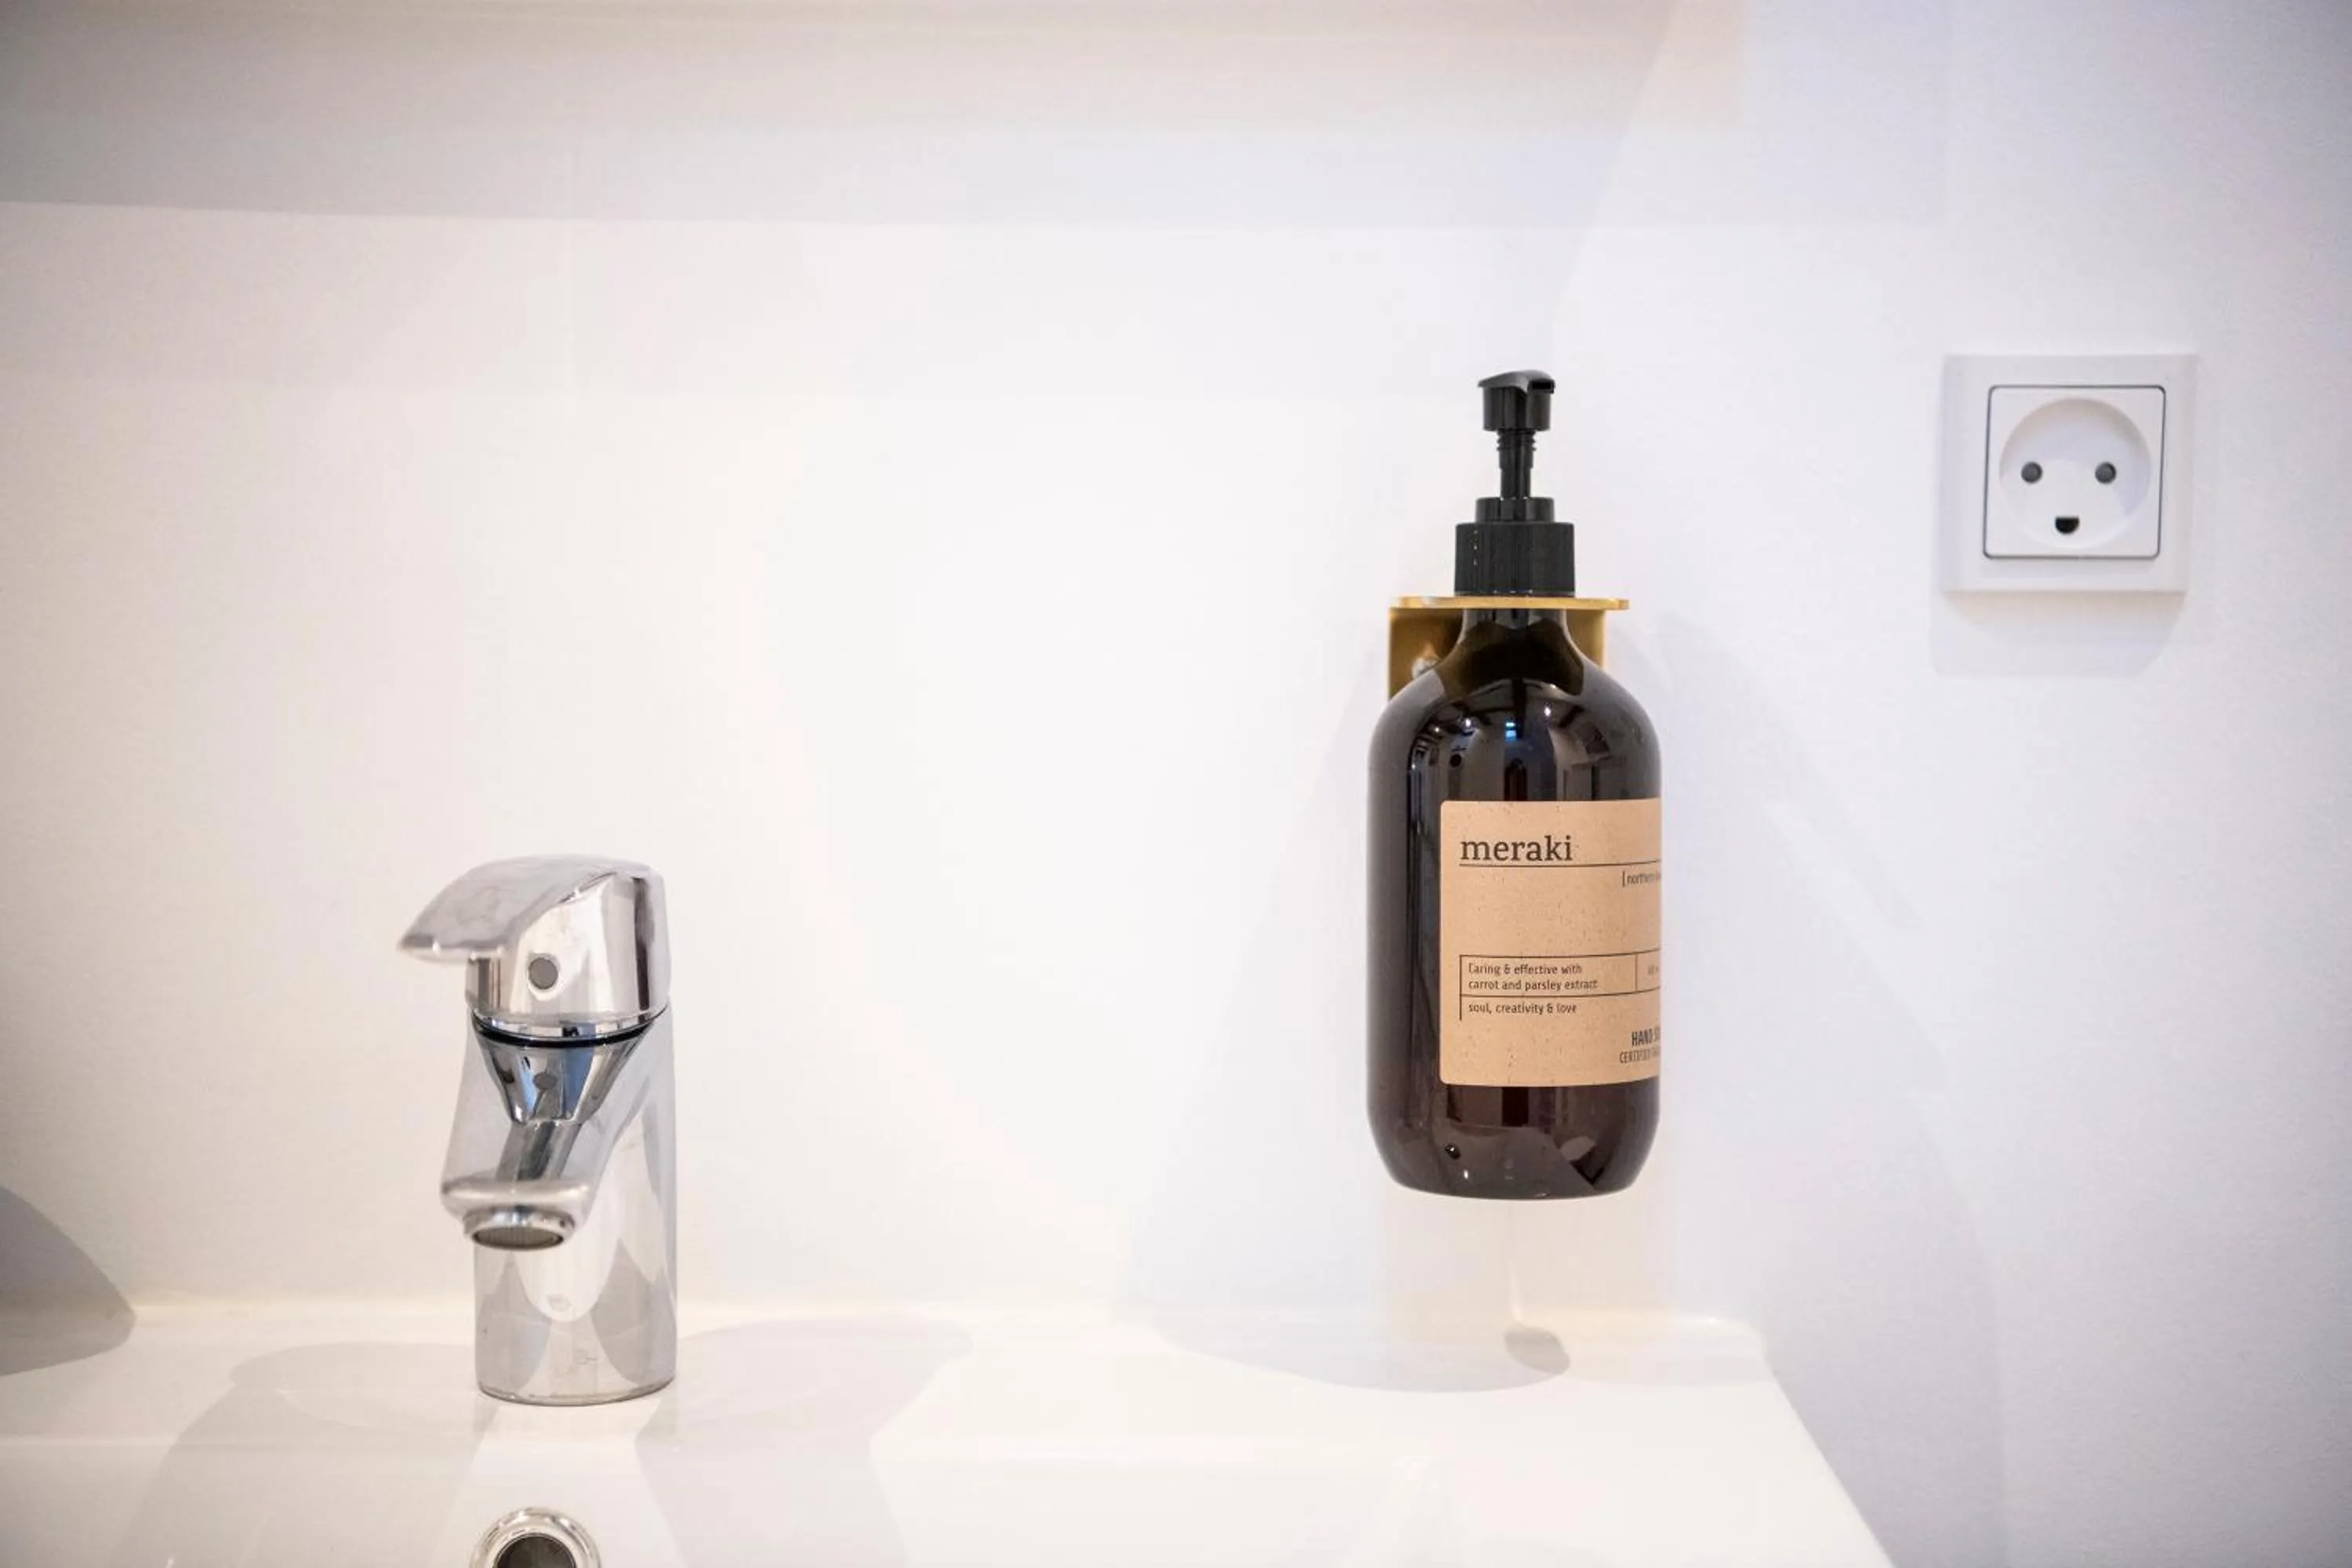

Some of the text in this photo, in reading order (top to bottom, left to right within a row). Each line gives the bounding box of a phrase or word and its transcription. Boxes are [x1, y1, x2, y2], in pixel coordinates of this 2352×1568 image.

[1461, 835, 1573, 861] meraki
[1468, 963, 1582, 975] Caring & effective with
[1468, 980, 1598, 992] carrot and parsley extract
[1468, 1003, 1577, 1014] soul, creativity & love
